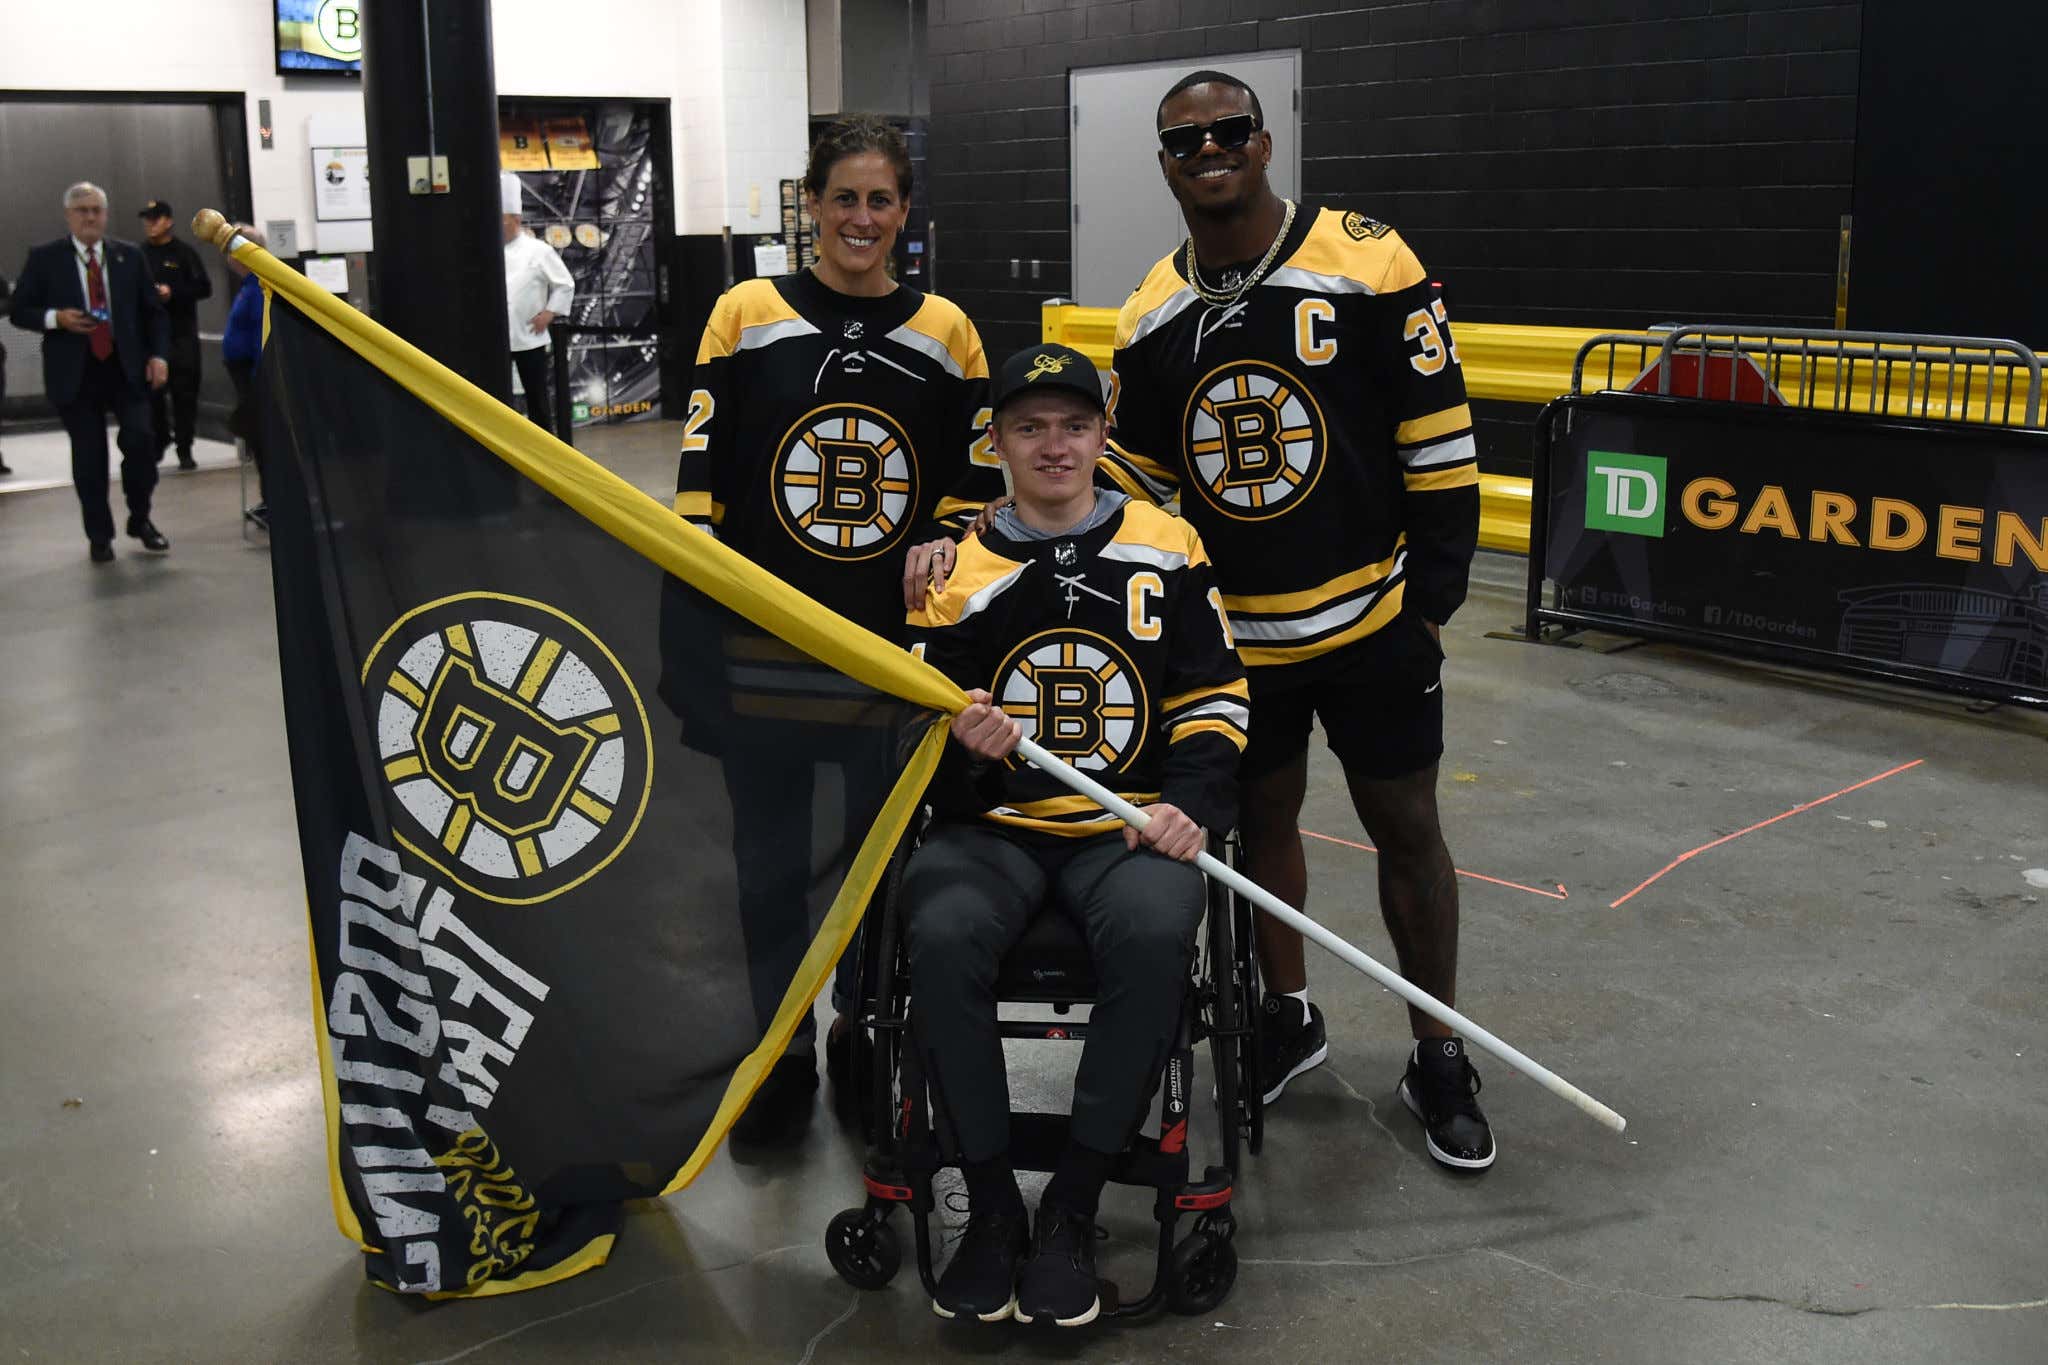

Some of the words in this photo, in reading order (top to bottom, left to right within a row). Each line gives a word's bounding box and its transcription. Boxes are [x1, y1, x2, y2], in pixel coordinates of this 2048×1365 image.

[1294, 297, 1338, 367] C
[813, 439, 884, 526] B
[1213, 397, 1286, 487] B
[1594, 465, 1659, 519] TD
[1681, 476, 2048, 573] GARDEN
[1127, 571, 1165, 641] C
[1033, 668, 1104, 755] B
